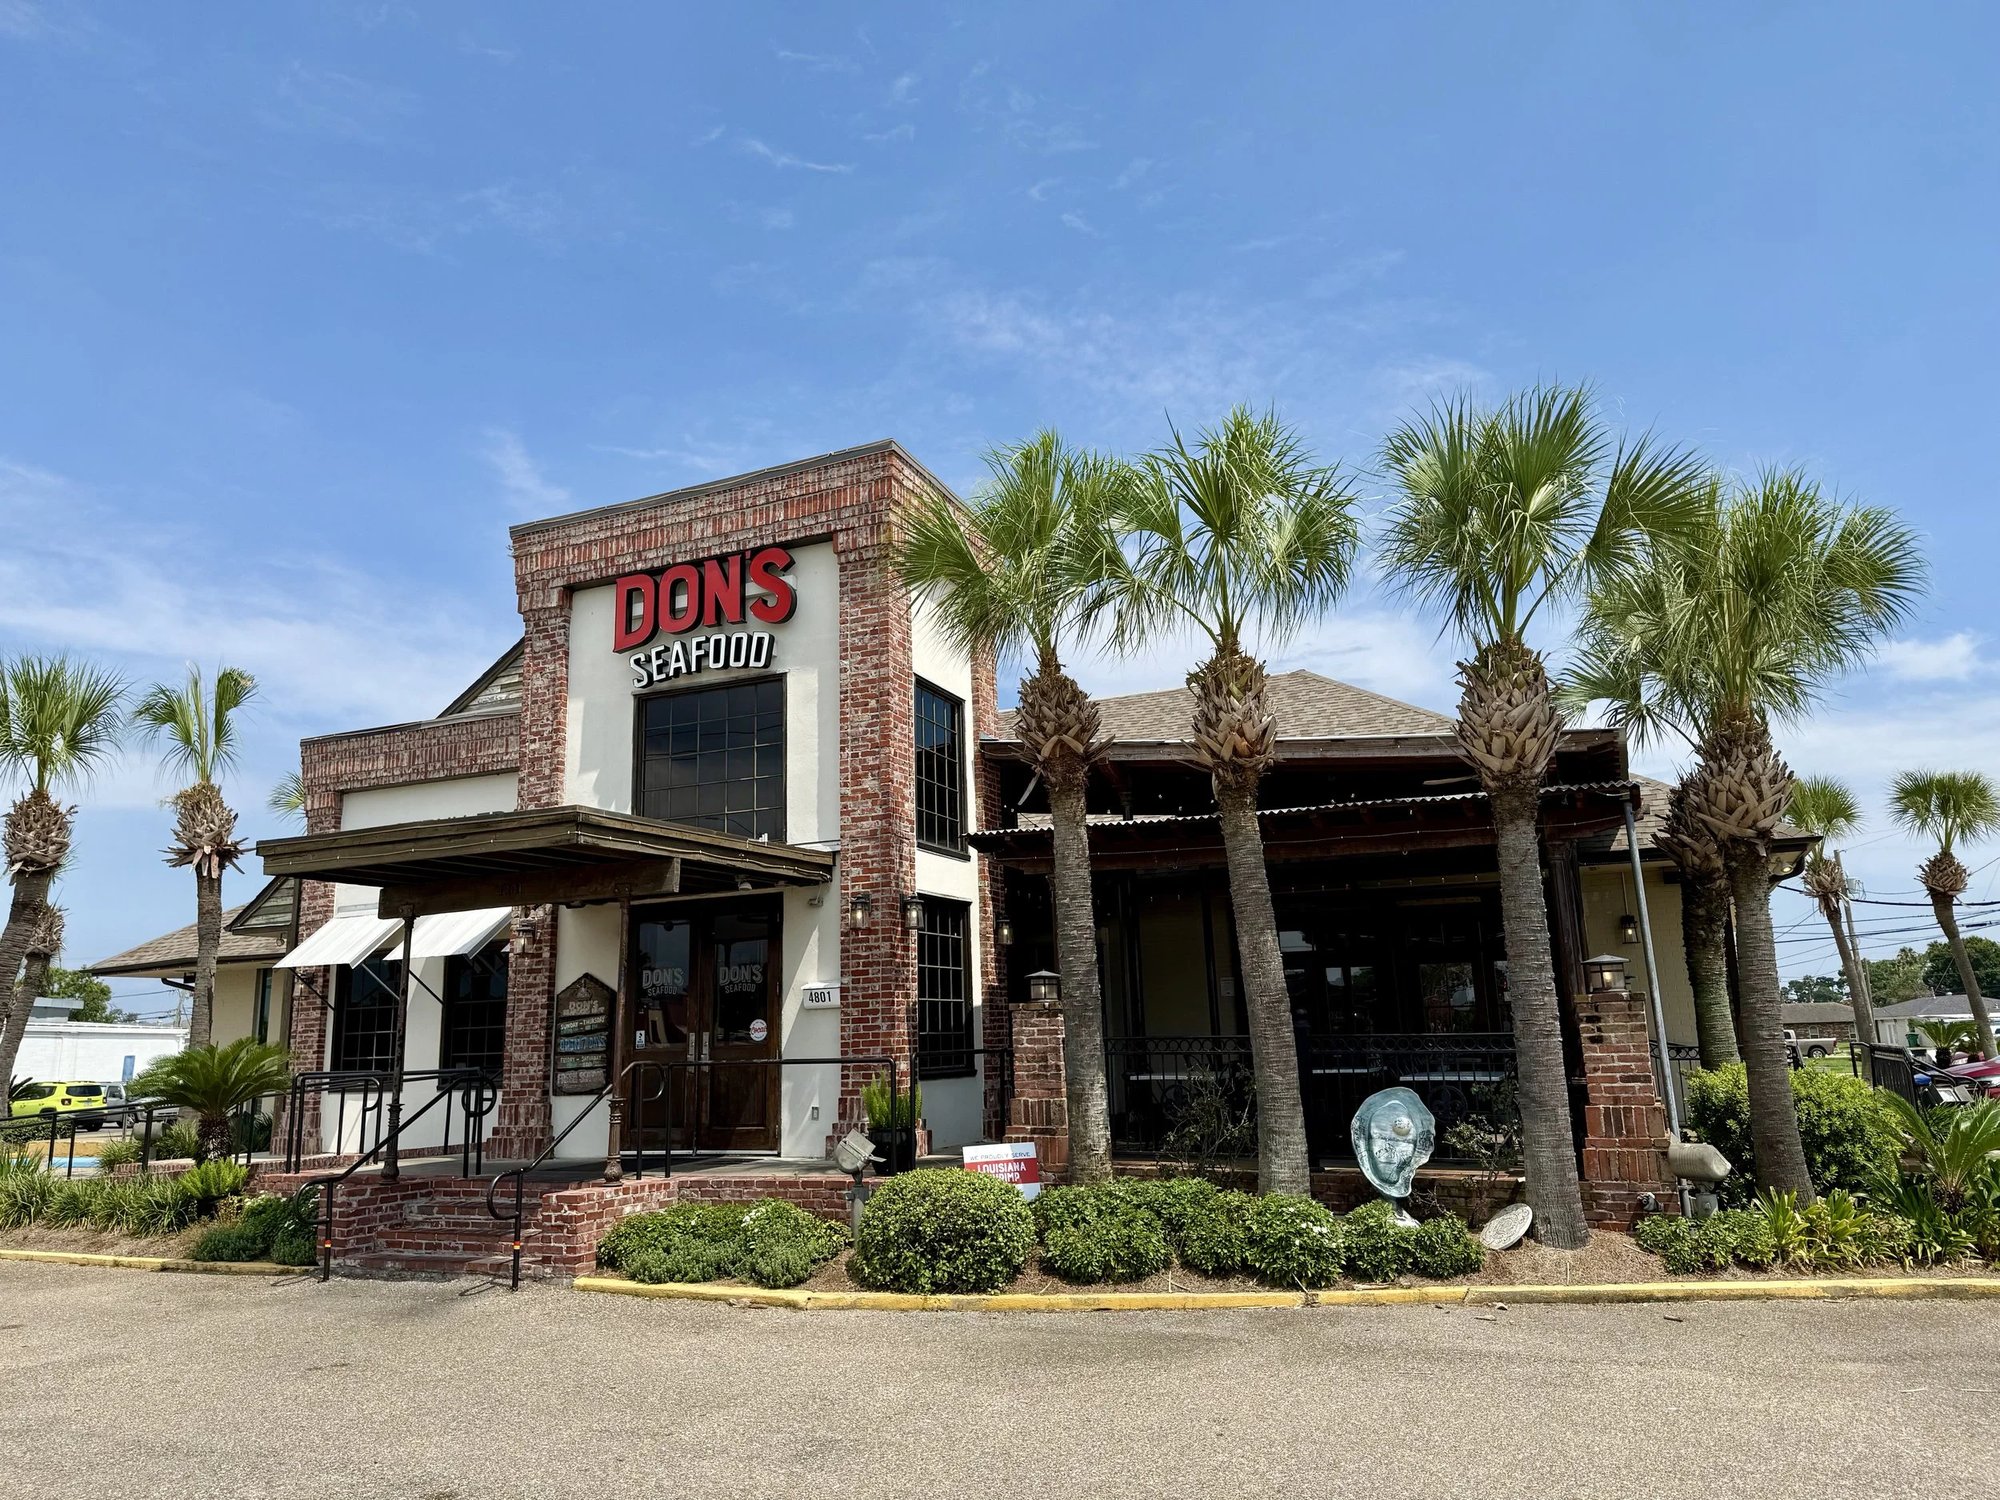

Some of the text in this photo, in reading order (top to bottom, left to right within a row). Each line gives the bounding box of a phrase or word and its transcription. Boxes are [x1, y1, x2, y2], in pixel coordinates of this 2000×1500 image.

[613, 547, 796, 654] DON'S
[629, 631, 774, 689] SEAFOOD
[642, 967, 684, 989] DON'S
[719, 964, 763, 986] DON'S
[647, 986, 678, 997] SEAFOOD
[725, 983, 756, 994] SEAFOOD
[808, 991, 832, 1003] 4801
[977, 1161, 1027, 1173] LOUISIANA
